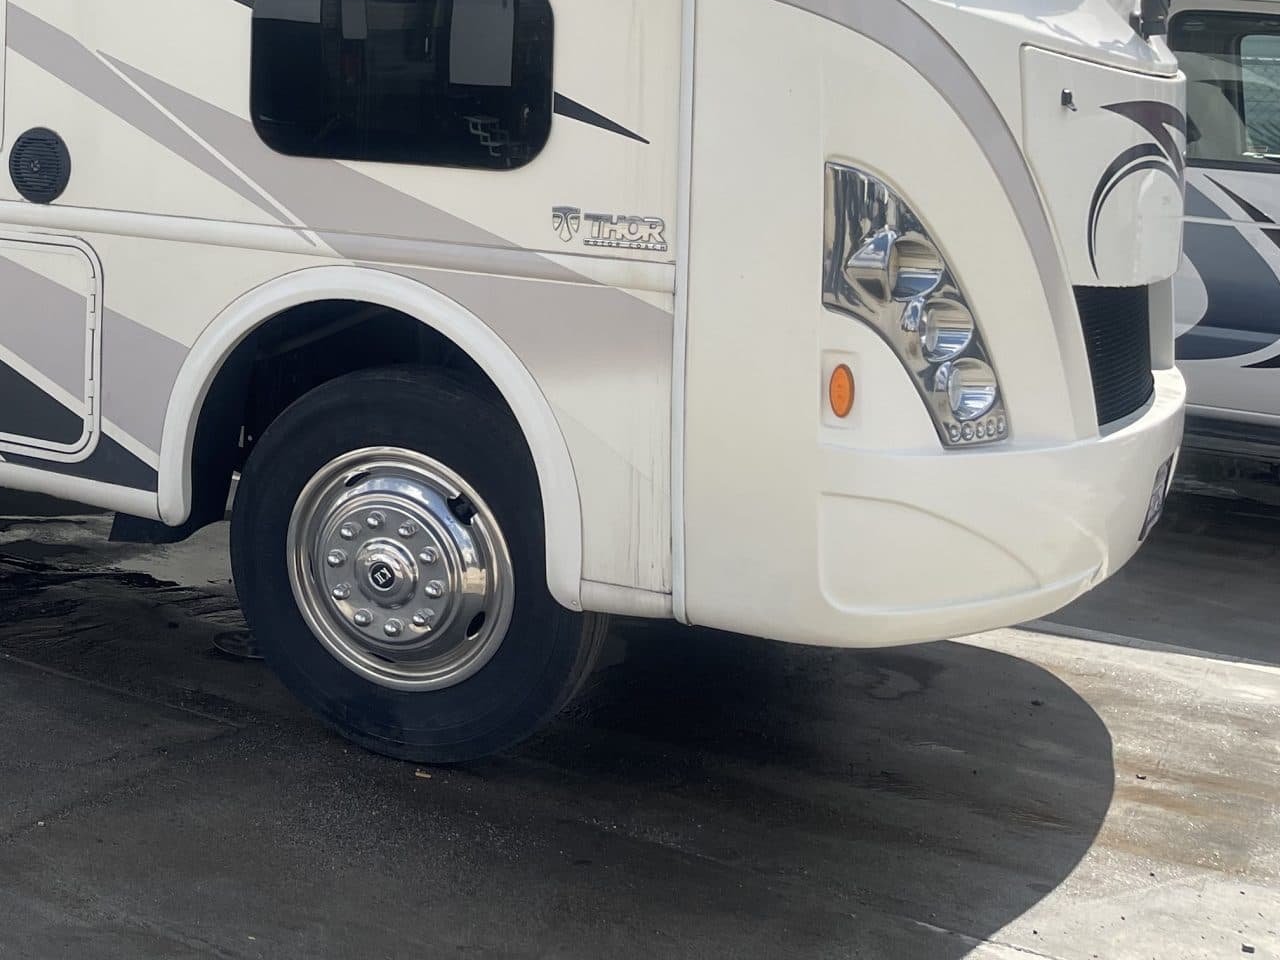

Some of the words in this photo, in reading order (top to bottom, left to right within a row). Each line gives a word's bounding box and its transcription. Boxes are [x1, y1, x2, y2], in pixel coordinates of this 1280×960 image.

[584, 212, 666, 244] THOR
[584, 239, 621, 248] MOTOR
[628, 242, 667, 251] COACH
